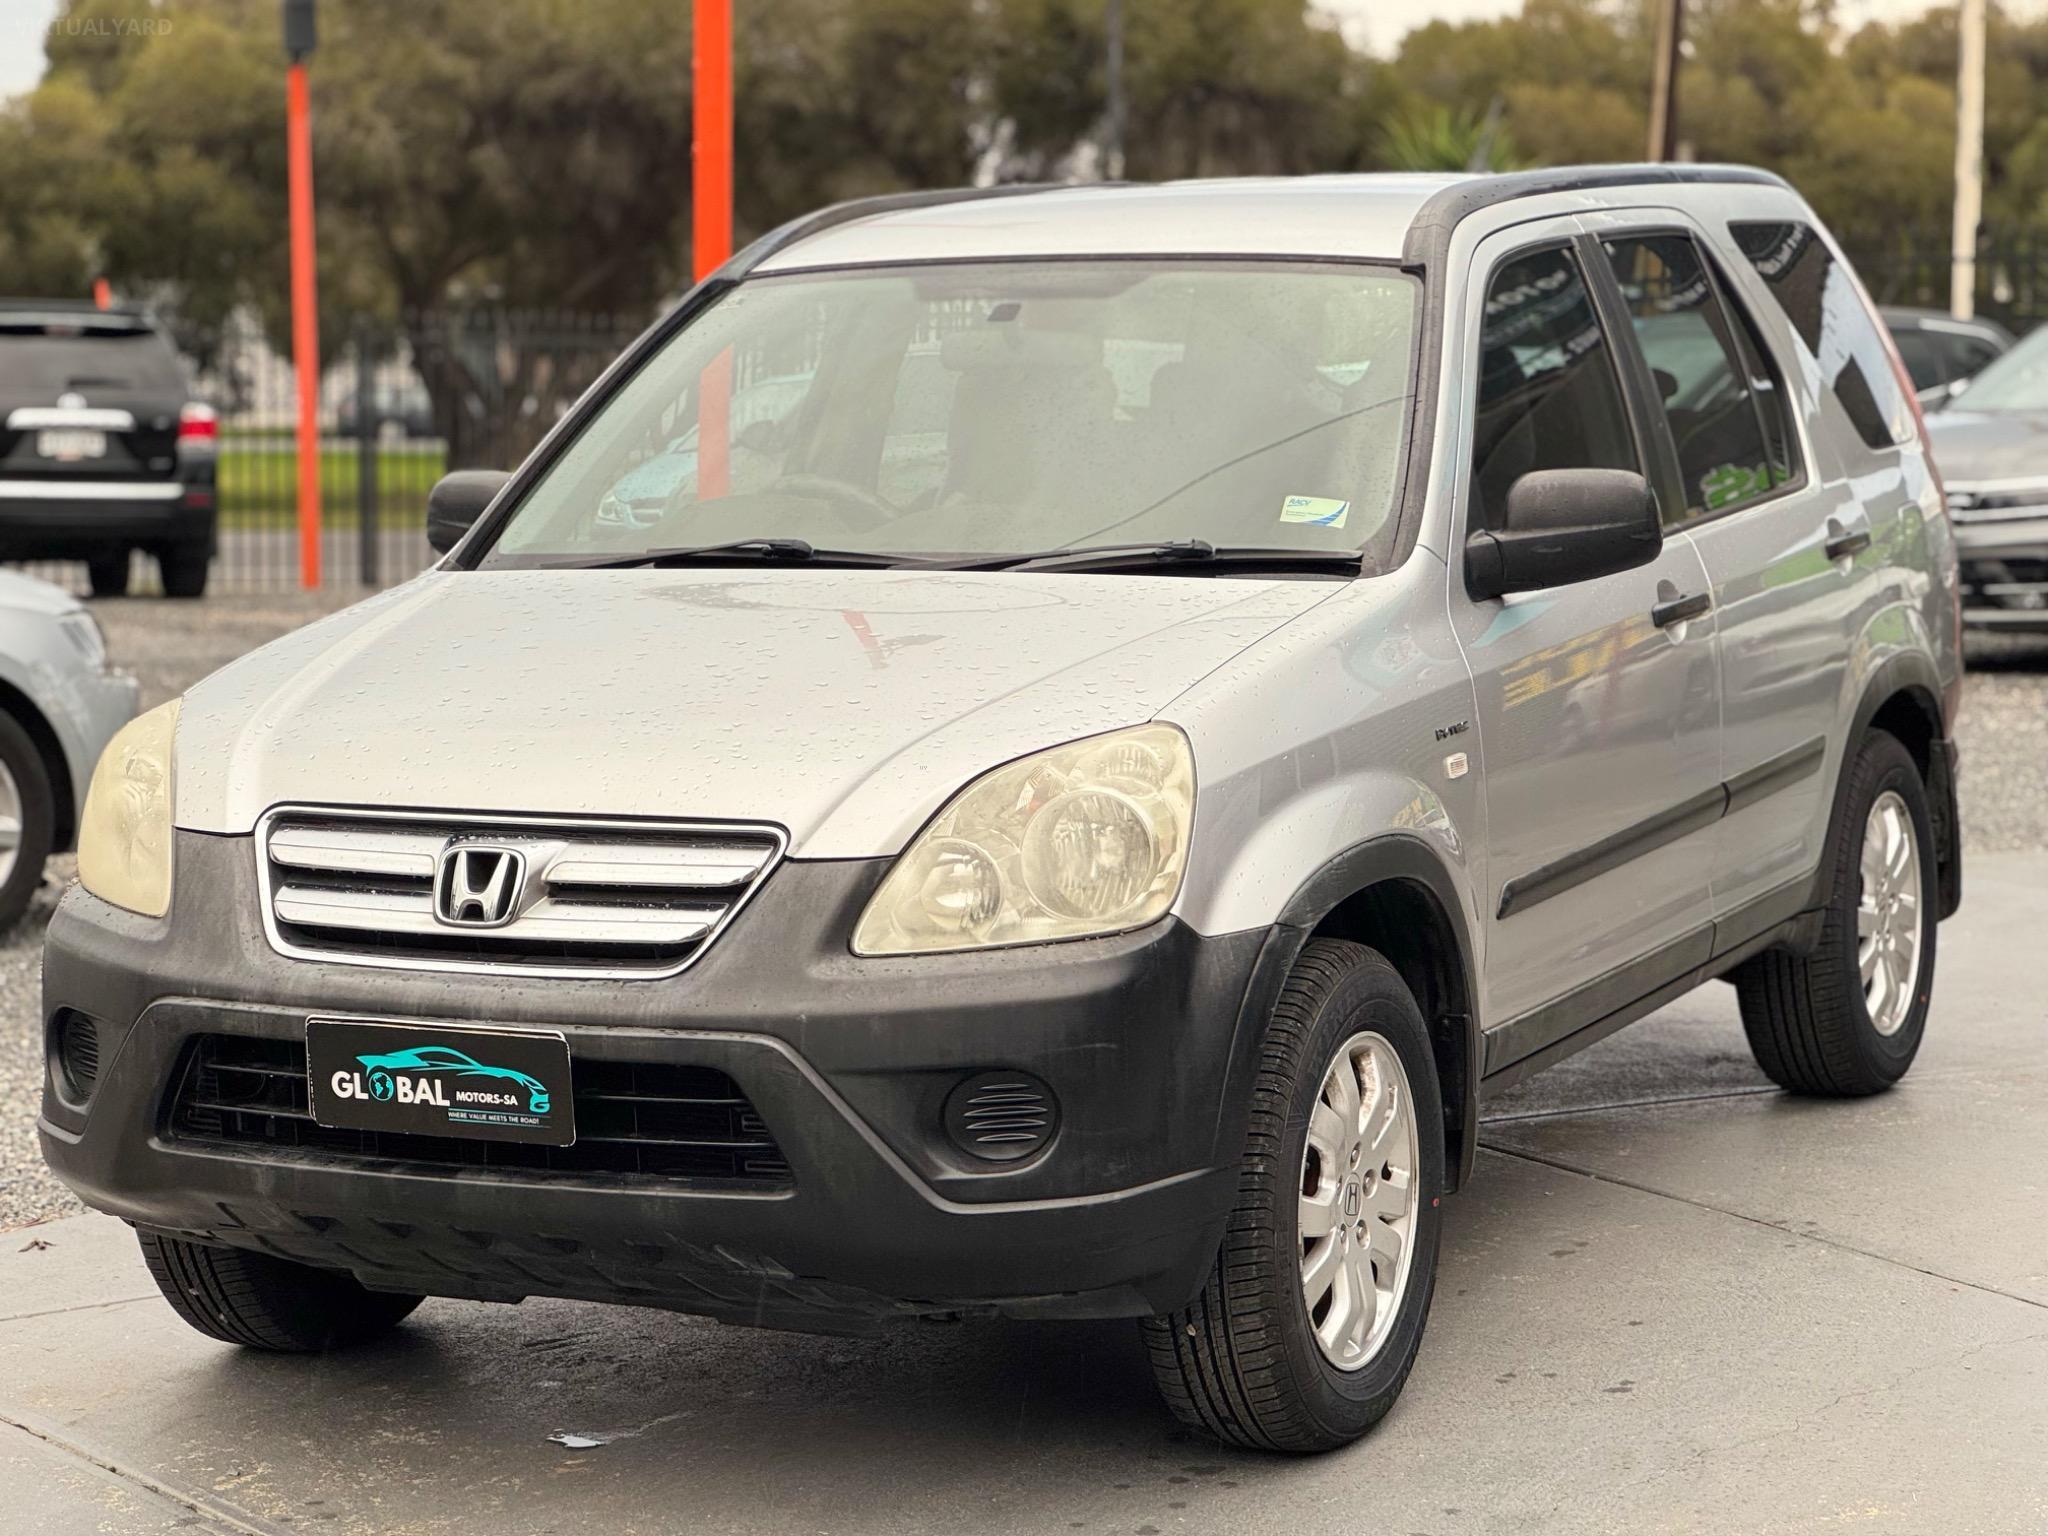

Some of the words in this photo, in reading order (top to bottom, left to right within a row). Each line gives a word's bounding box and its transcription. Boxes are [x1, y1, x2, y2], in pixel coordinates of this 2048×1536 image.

[331, 1071, 450, 1106] GLOBAL
[456, 1091, 518, 1106] MOTORS-SA
[448, 1111, 467, 1119] WHERE
[468, 1113, 487, 1121] VALUE
[488, 1114, 507, 1123] MEETS
